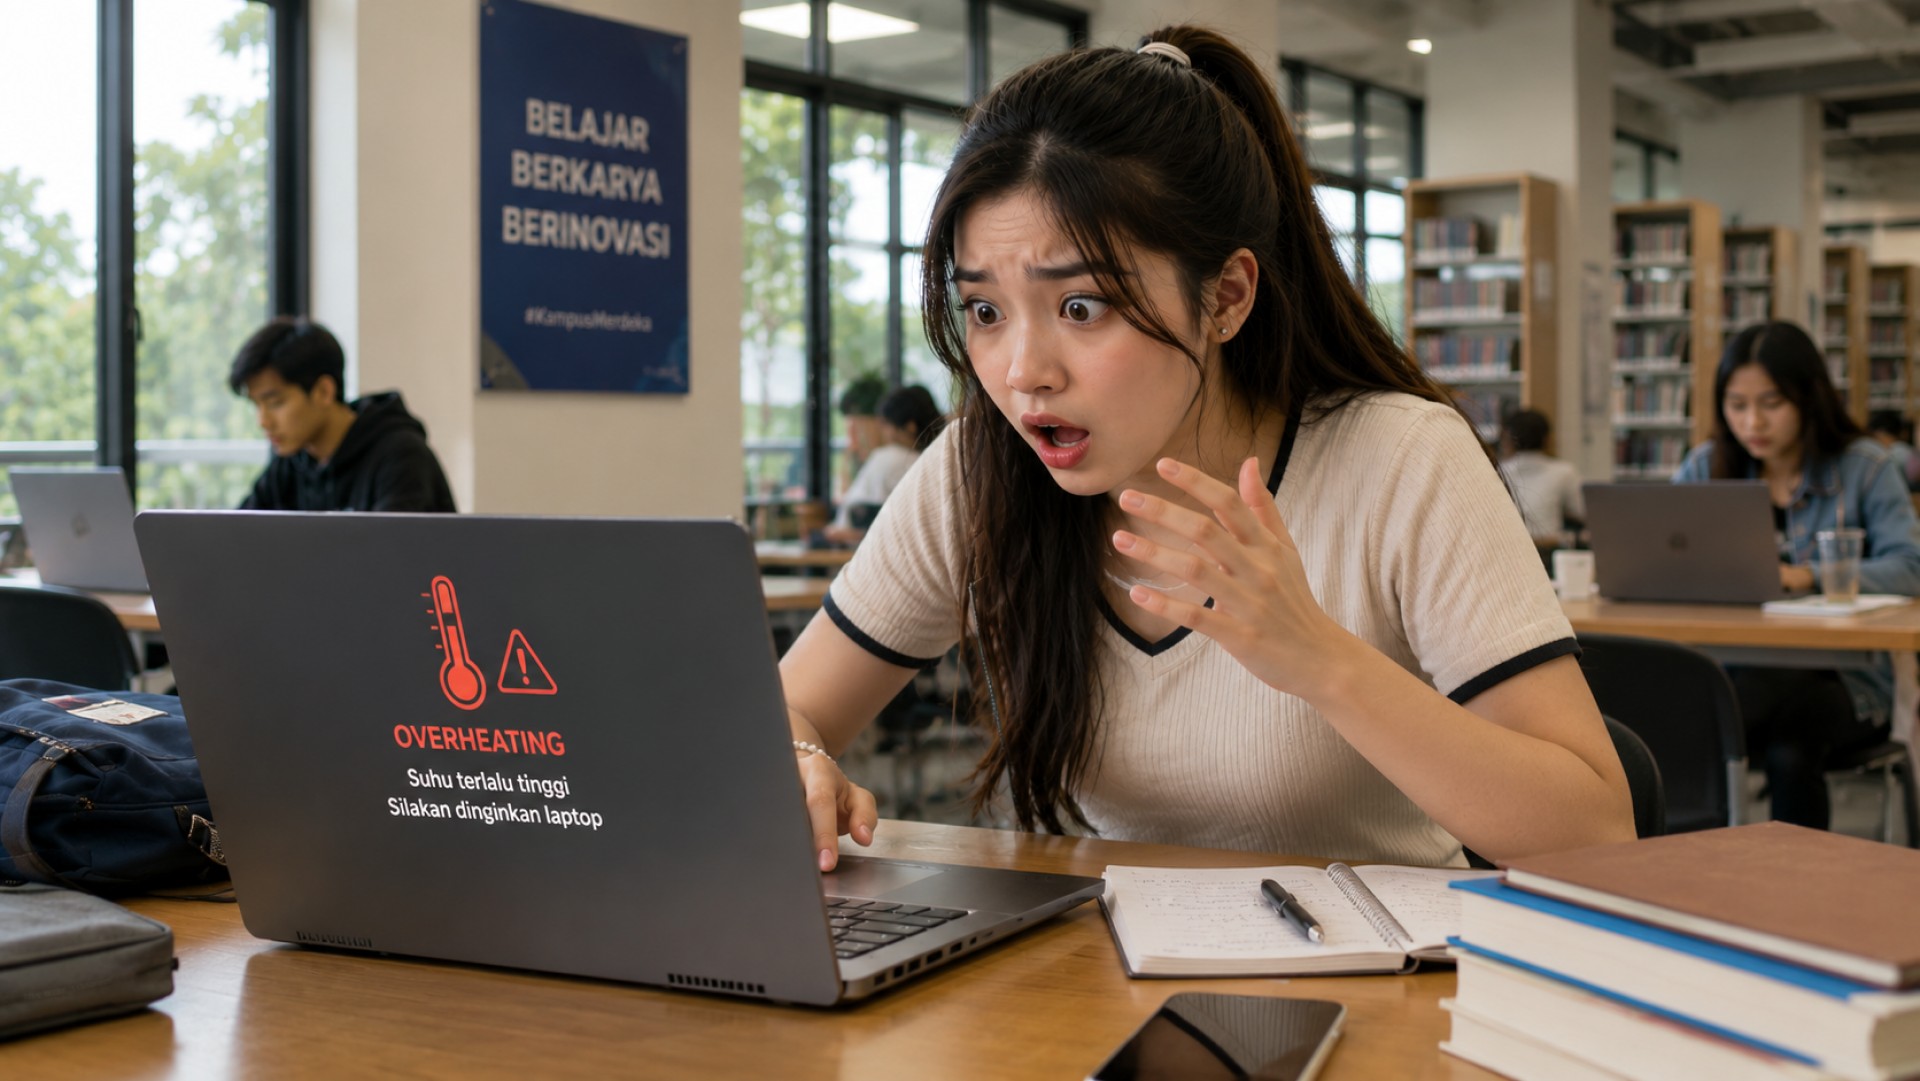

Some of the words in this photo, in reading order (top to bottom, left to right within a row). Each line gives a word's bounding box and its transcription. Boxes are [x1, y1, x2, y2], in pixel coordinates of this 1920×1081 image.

[526, 99, 649, 151] BELAJAR
[511, 150, 662, 203] BERKARYA
[502, 206, 670, 257] BERINOVASI
[525, 307, 652, 332] #KampusMerdeka
[394, 724, 566, 756] OVERHEATING
[407, 768, 454, 789] Suhu
[456, 771, 514, 792] terlalu
[517, 774, 571, 799] tinggi
[388, 797, 452, 818] Silakan
[455, 800, 542, 825] dinginkan
[544, 805, 603, 831] laptop
